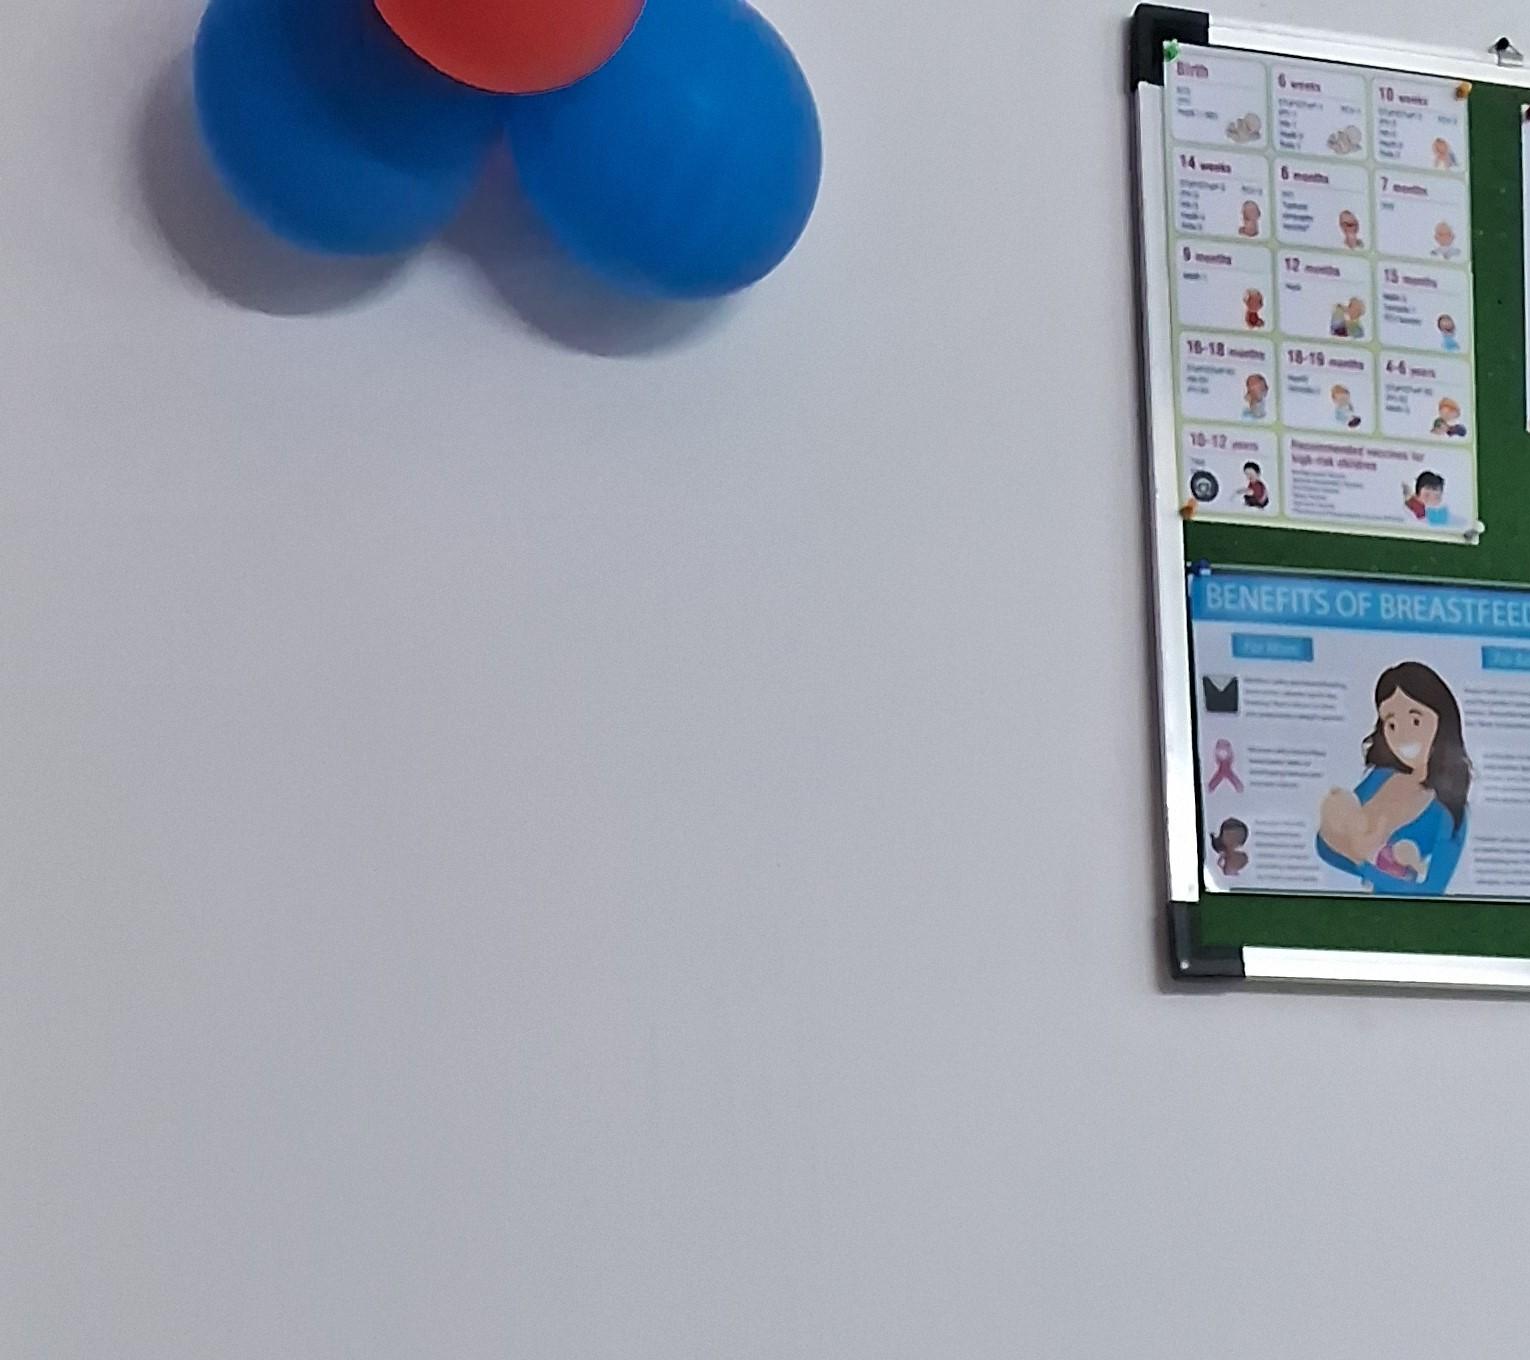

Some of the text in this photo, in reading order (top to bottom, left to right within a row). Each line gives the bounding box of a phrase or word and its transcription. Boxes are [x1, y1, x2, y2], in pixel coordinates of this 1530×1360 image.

[1176, 61, 1209, 79] Birth
[1278, 73, 1286, 88] 6
[1180, 154, 1232, 174] 14 weeks
[1381, 176, 1388, 192] 7
[1285, 257, 1300, 272] 12
[1206, 582, 1331, 616] BENEFITS
[1336, 589, 1371, 618] OF
